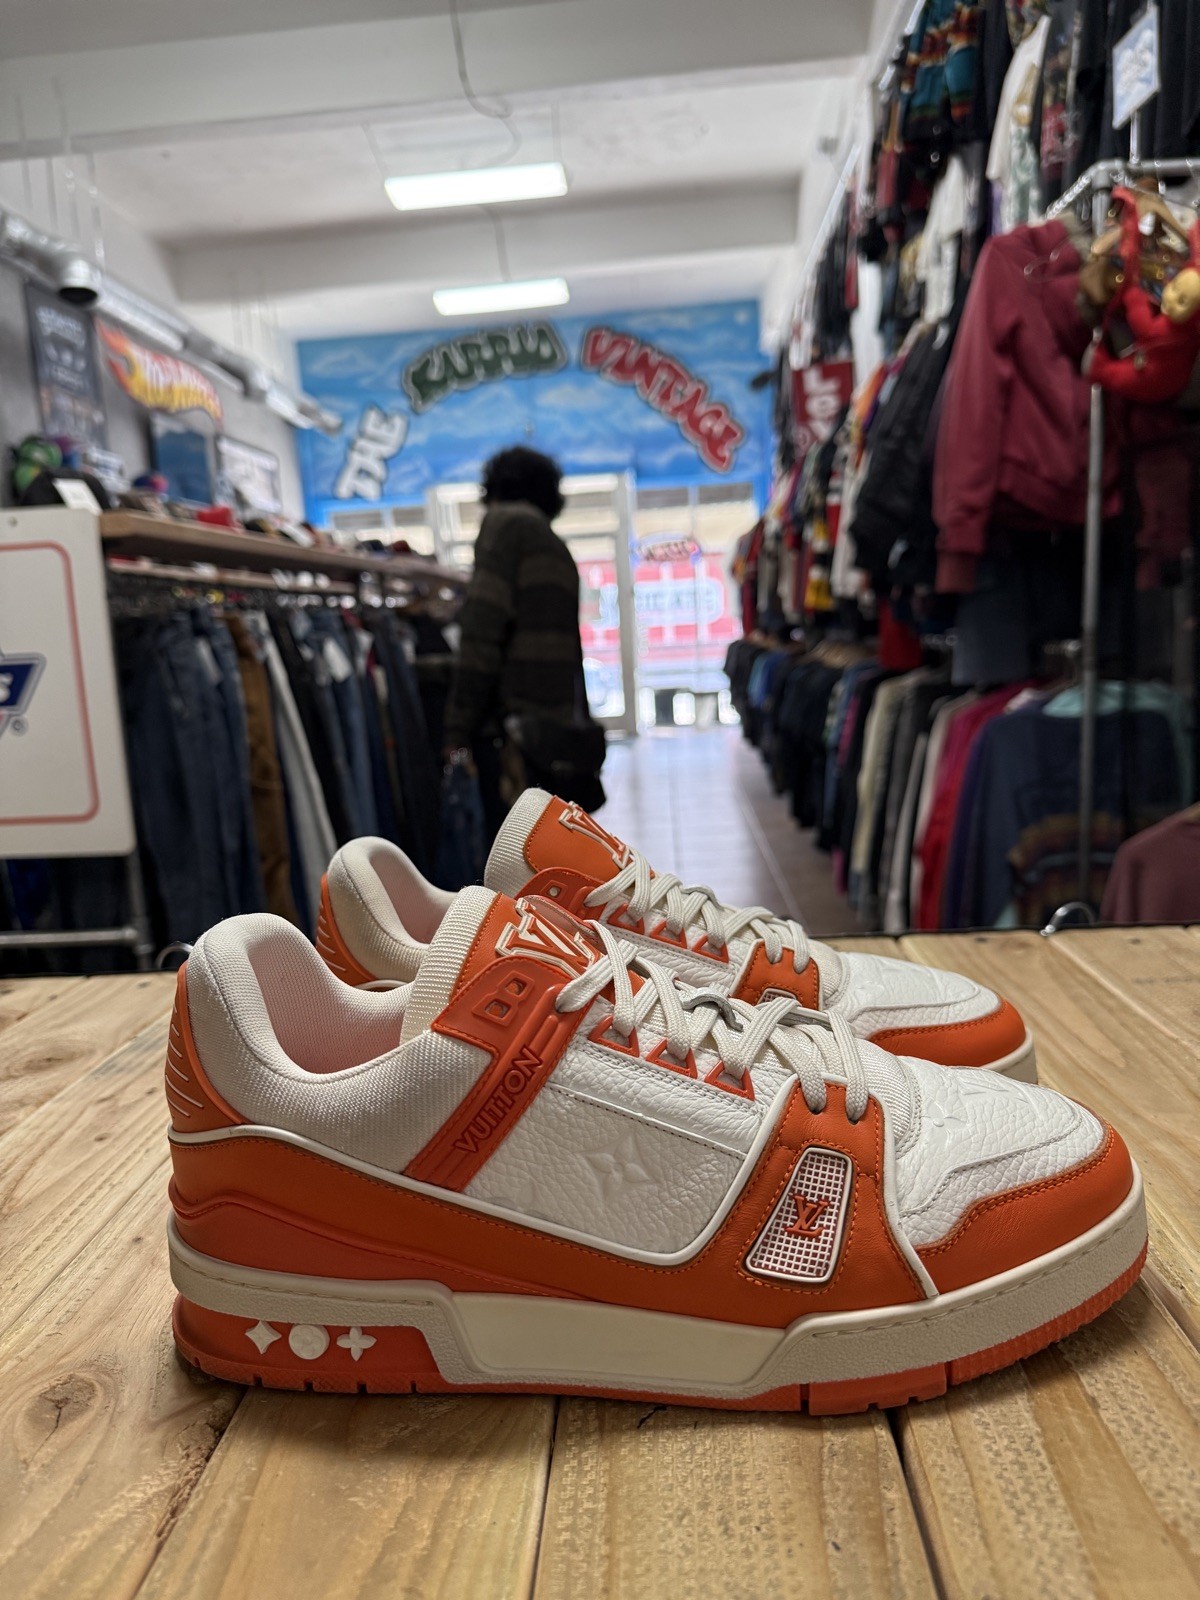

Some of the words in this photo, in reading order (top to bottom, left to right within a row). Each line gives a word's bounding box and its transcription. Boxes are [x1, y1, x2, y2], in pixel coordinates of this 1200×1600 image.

[333, 404, 409, 501] THE
[581, 325, 746, 474] VINTAGE
[454, 1045, 543, 1153] VUITTON
[784, 1195, 830, 1238] LV
